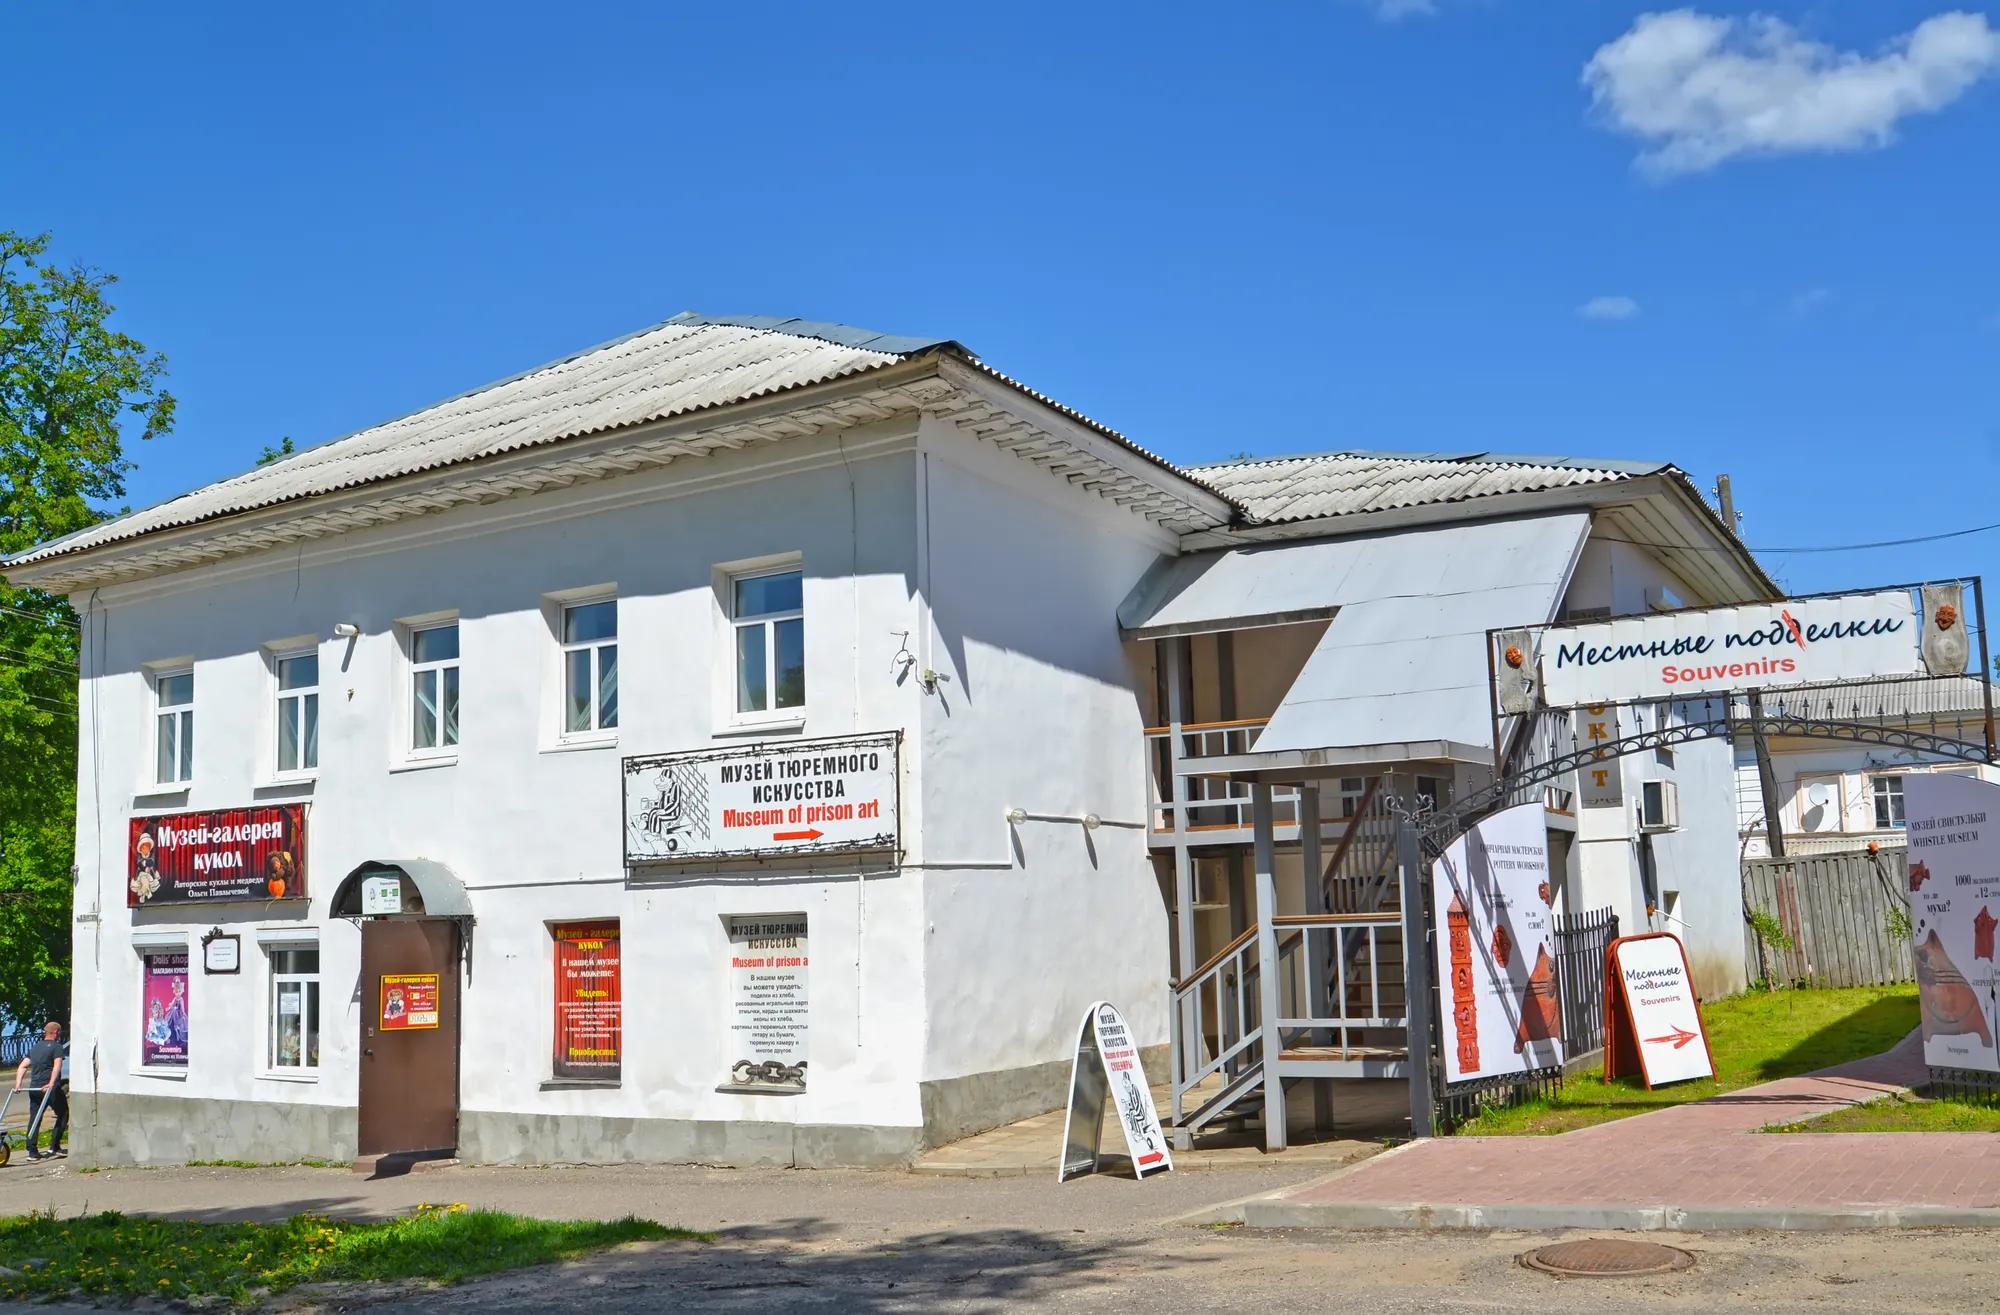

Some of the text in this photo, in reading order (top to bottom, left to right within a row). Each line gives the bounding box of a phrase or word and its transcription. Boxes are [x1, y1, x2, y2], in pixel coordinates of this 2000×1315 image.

[1556, 634, 1714, 669] Местные
[1661, 656, 1796, 684] Souvenirs
[721, 753, 879, 784] МУЗЕЙ ТЮРЕМНОГО
[752, 779, 845, 804] ИСКУССТВА
[723, 799, 879, 828] Museum of prison art
[1911, 812, 1987, 832] МУЗЕЙ СВИСТУЛЬКИ
[157, 821, 283, 851] Музей-галерея
[1912, 830, 1979, 847] WHISTLE MUSEUM
[1511, 845, 1544, 856] МАСТЕРСКАЯ
[193, 851, 243, 874] кукол
[1493, 860, 1545, 871] POTTERY WORKSHOP
[173, 880, 207, 889] Авторские
[208, 879, 229, 889] куклы
[236, 877, 264, 886] медведи
[1954, 874, 1972, 887] 1000
[188, 889, 208, 898] Ольги
[1980, 886, 1989, 898] 12
[1926, 899, 1951, 916] муха?
[556, 929, 583, 940] Музей
[731, 923, 760, 936] МУЗЕЙ
[578, 941, 604, 951] кукол
[748, 937, 797, 950] ИСКУССТВА
[171, 955, 188, 966] shop
[562, 958, 620, 968] В нашем музее
[732, 957, 765, 968] Museum
[766, 956, 774, 967] of
[775, 956, 801, 968] prison
[152, 967, 173, 975] МАГАЗИН
[1625, 966, 1682, 981] Местные
[575, 989, 609, 999] Увидеть:
[1640, 994, 1680, 1006] Souvenirs
[1100, 1012, 1116, 1024] МУЗЕЙ
[158, 1045, 182, 1053] Souvenirs
[569, 1047, 617, 1058] Приобрести:
